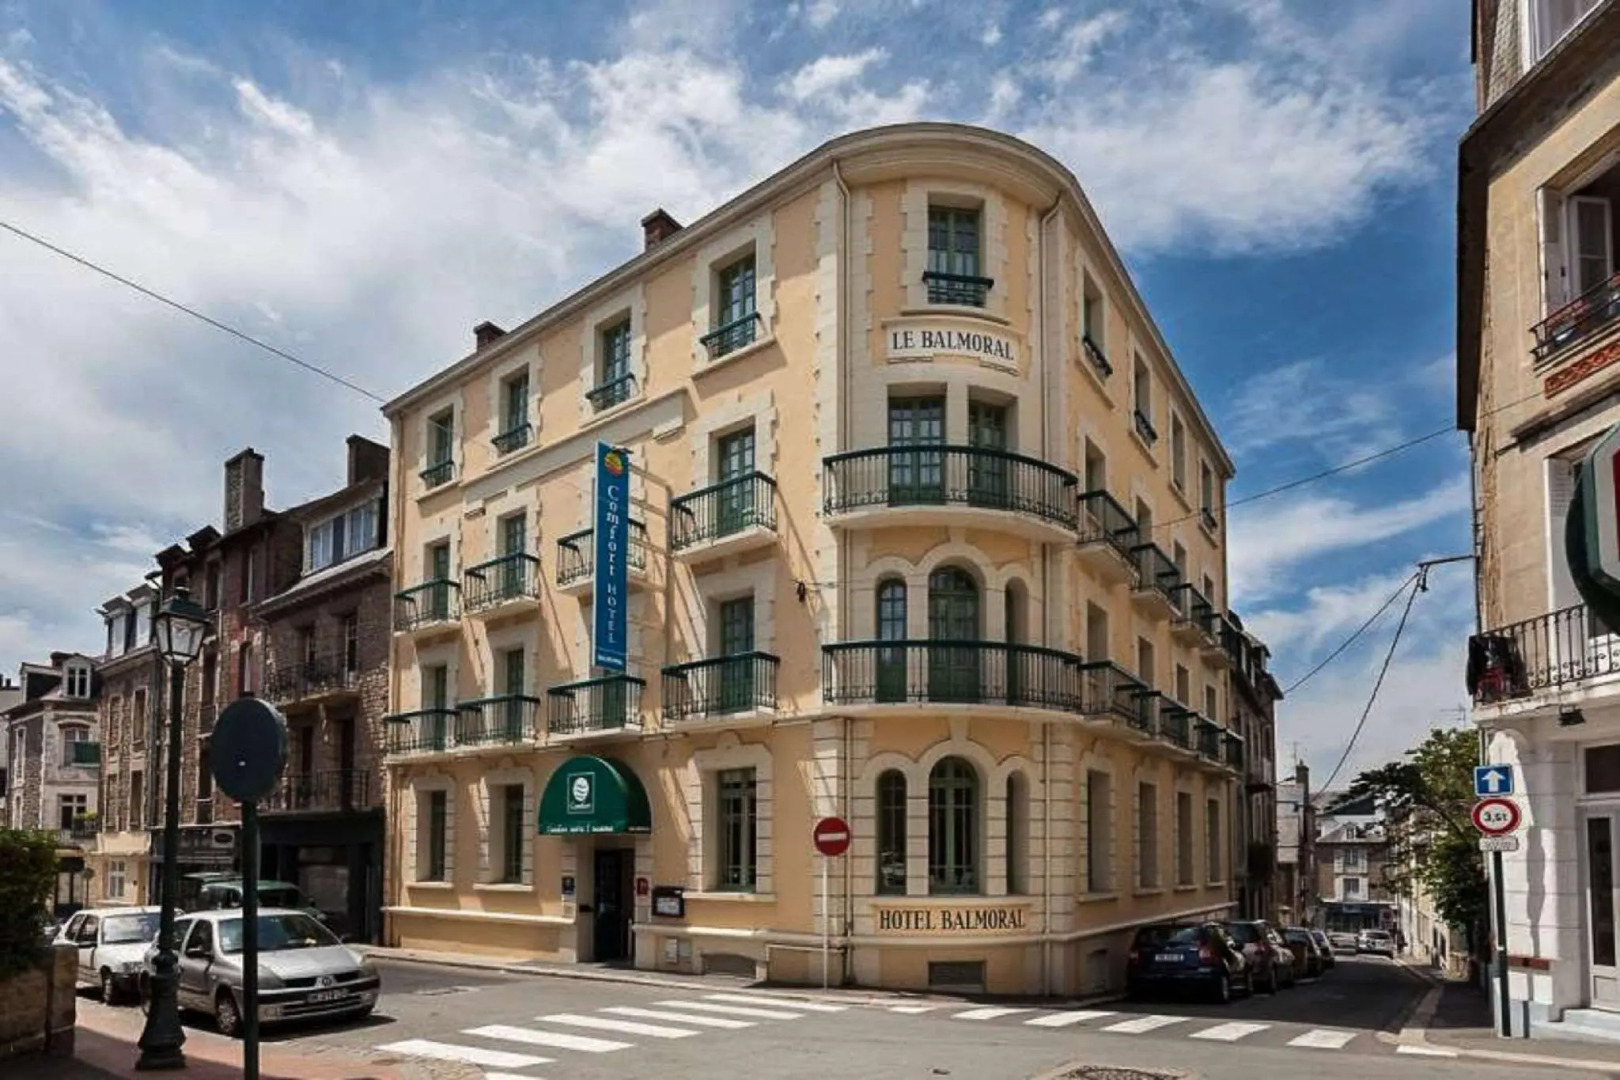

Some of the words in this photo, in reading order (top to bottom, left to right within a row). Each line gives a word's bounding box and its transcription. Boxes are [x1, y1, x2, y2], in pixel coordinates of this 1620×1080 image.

[892, 330, 914, 350] LE
[921, 330, 1014, 360] BALMORAL
[607, 583, 617, 643] HOTEL
[879, 910, 935, 930] HOTEL
[941, 909, 1026, 930] BALMORAL
